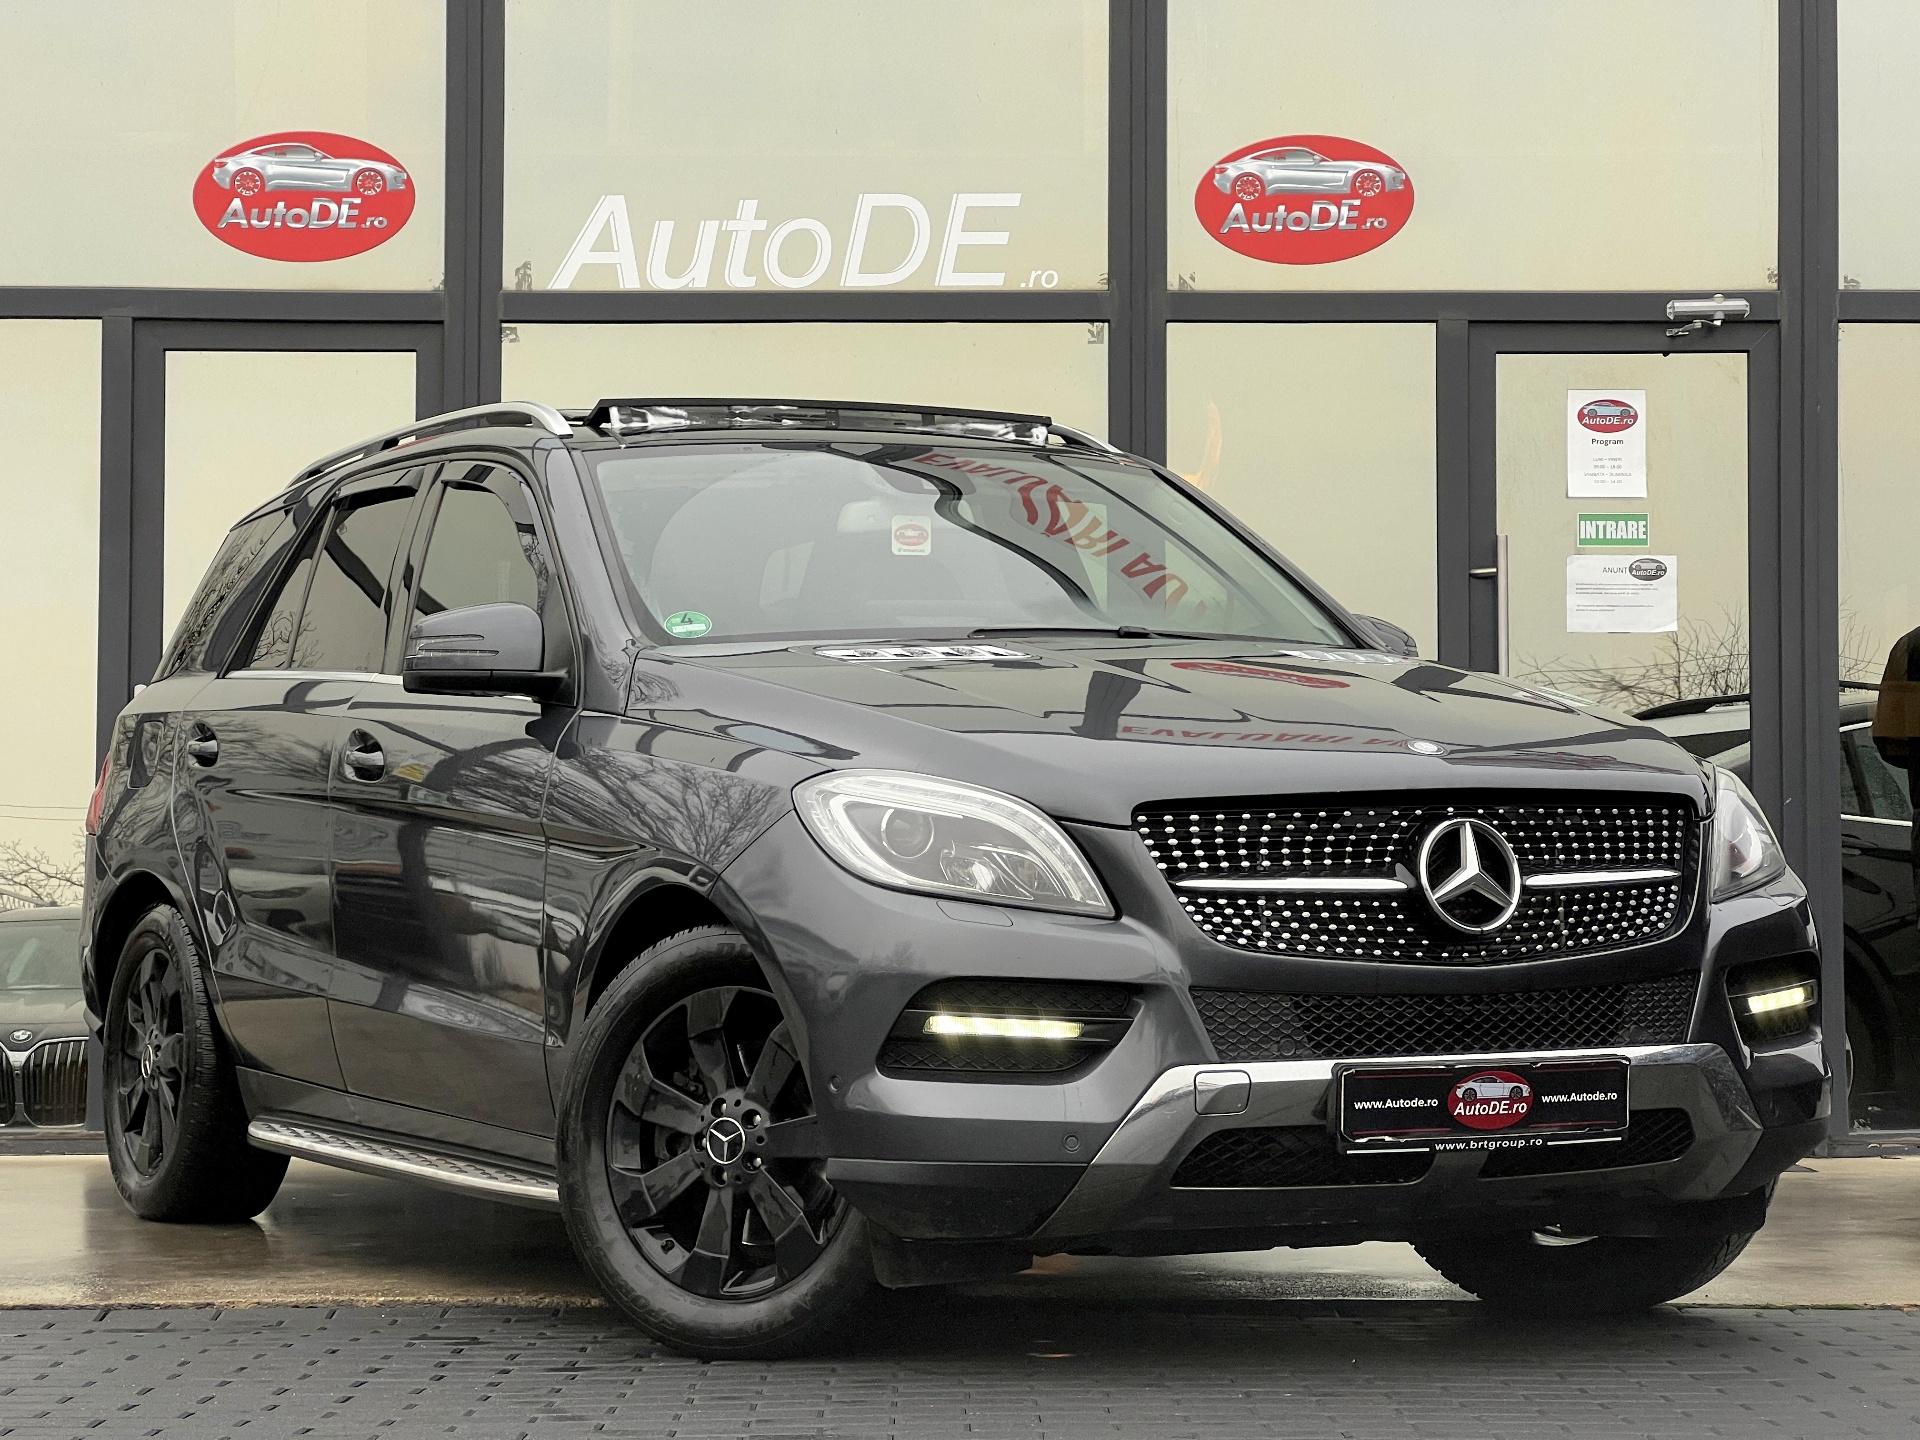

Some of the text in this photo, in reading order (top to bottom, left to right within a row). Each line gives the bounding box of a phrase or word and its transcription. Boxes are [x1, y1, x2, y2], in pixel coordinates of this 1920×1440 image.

[1581, 416, 1634, 425] AutoDE.ro
[1591, 438, 1623, 446] Program
[1579, 520, 1647, 539] INTRARE
[1631, 569, 1665, 577] AutoDE.ro
[680, 612, 693, 624] 4
[1353, 1091, 1618, 1117] www.Autode.ro AutoDE.ro www.Autode.ro
[1434, 1136, 1543, 1151] www.brtgroup.ro
